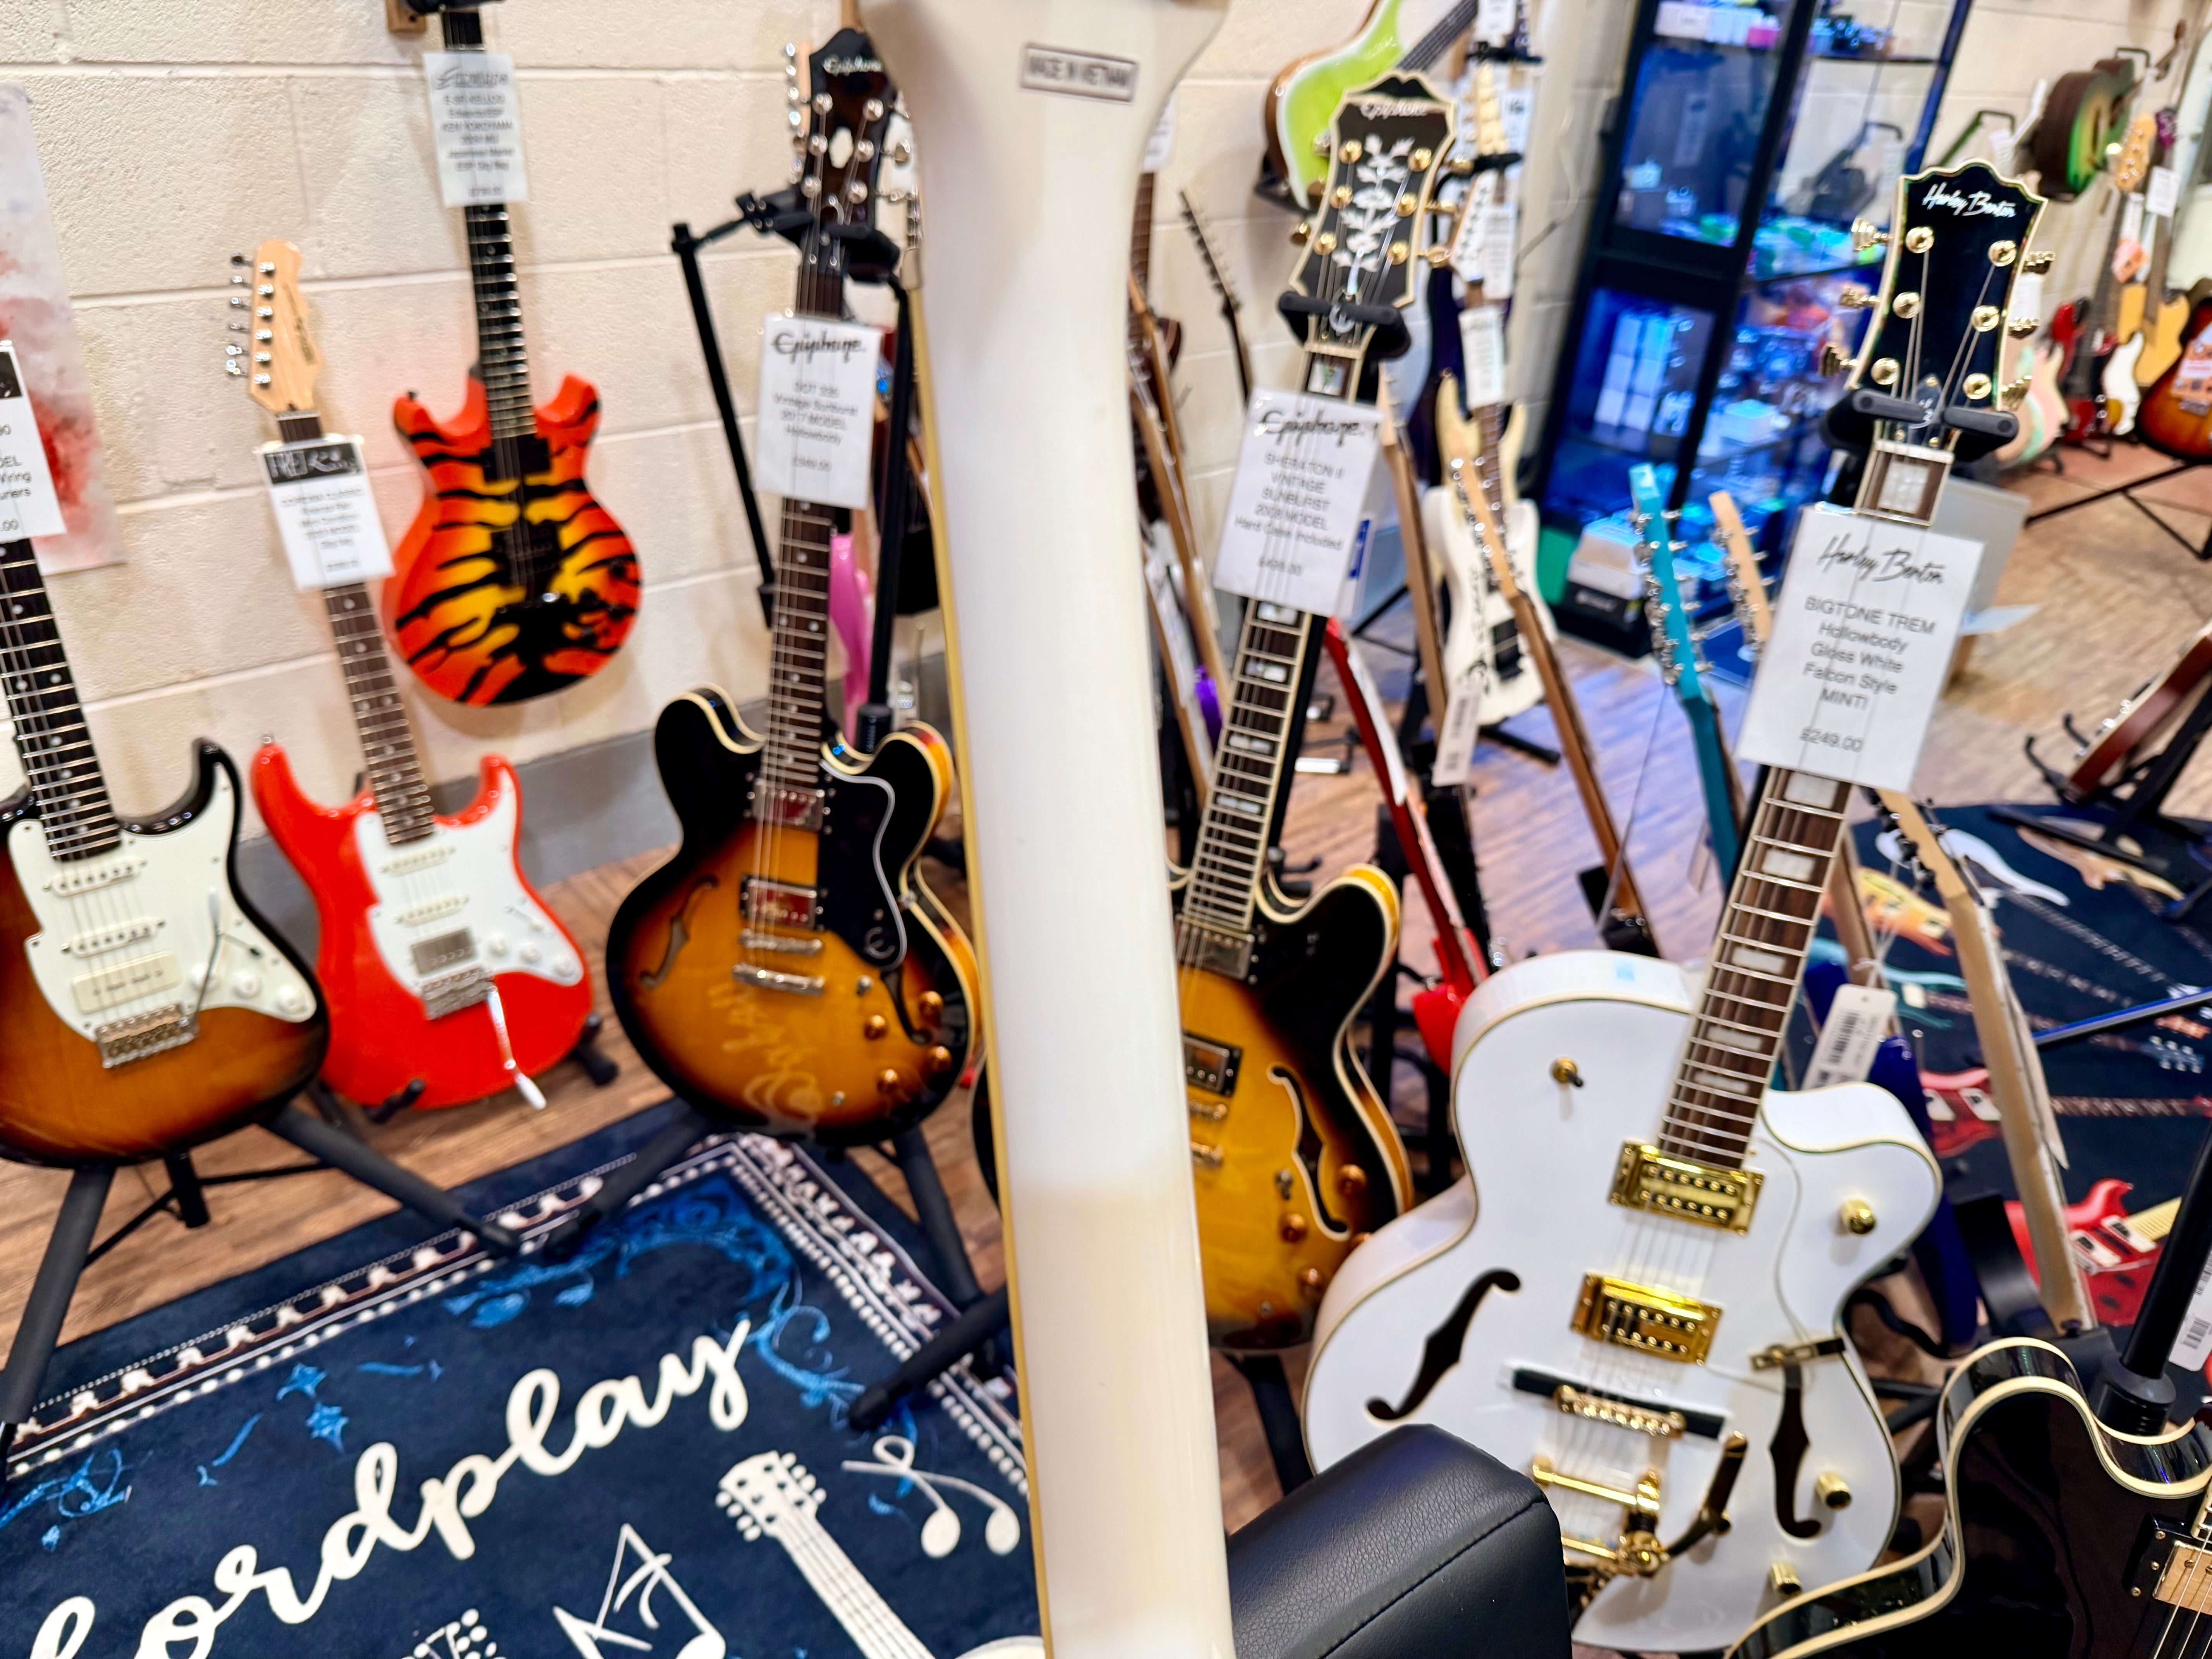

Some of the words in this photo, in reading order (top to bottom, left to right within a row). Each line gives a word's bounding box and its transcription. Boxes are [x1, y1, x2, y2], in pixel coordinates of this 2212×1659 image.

[1921, 181, 1968, 216] Harley
[1961, 190, 2017, 218] Benton
[771, 329, 863, 364] Epiphone
[1258, 409, 1360, 447] Epiphone
[1261, 487, 1330, 510] SUNBURST
[1271, 470, 1326, 494] VINTAGE
[1284, 508, 1329, 531] MODEL
[1817, 532, 1878, 580] Harley
[1872, 546, 1946, 584] Benton
[1804, 595, 1884, 625] BIGTONE
[1887, 611, 1937, 636] TREM
[1819, 621, 1909, 654] Hollowbody
[1810, 641, 1854, 663] Gloss
[1860, 652, 1904, 673] White
[1803, 661, 1856, 685] Falcon
[1858, 672, 1898, 694] Style
[1800, 725, 1863, 753] £249.00
